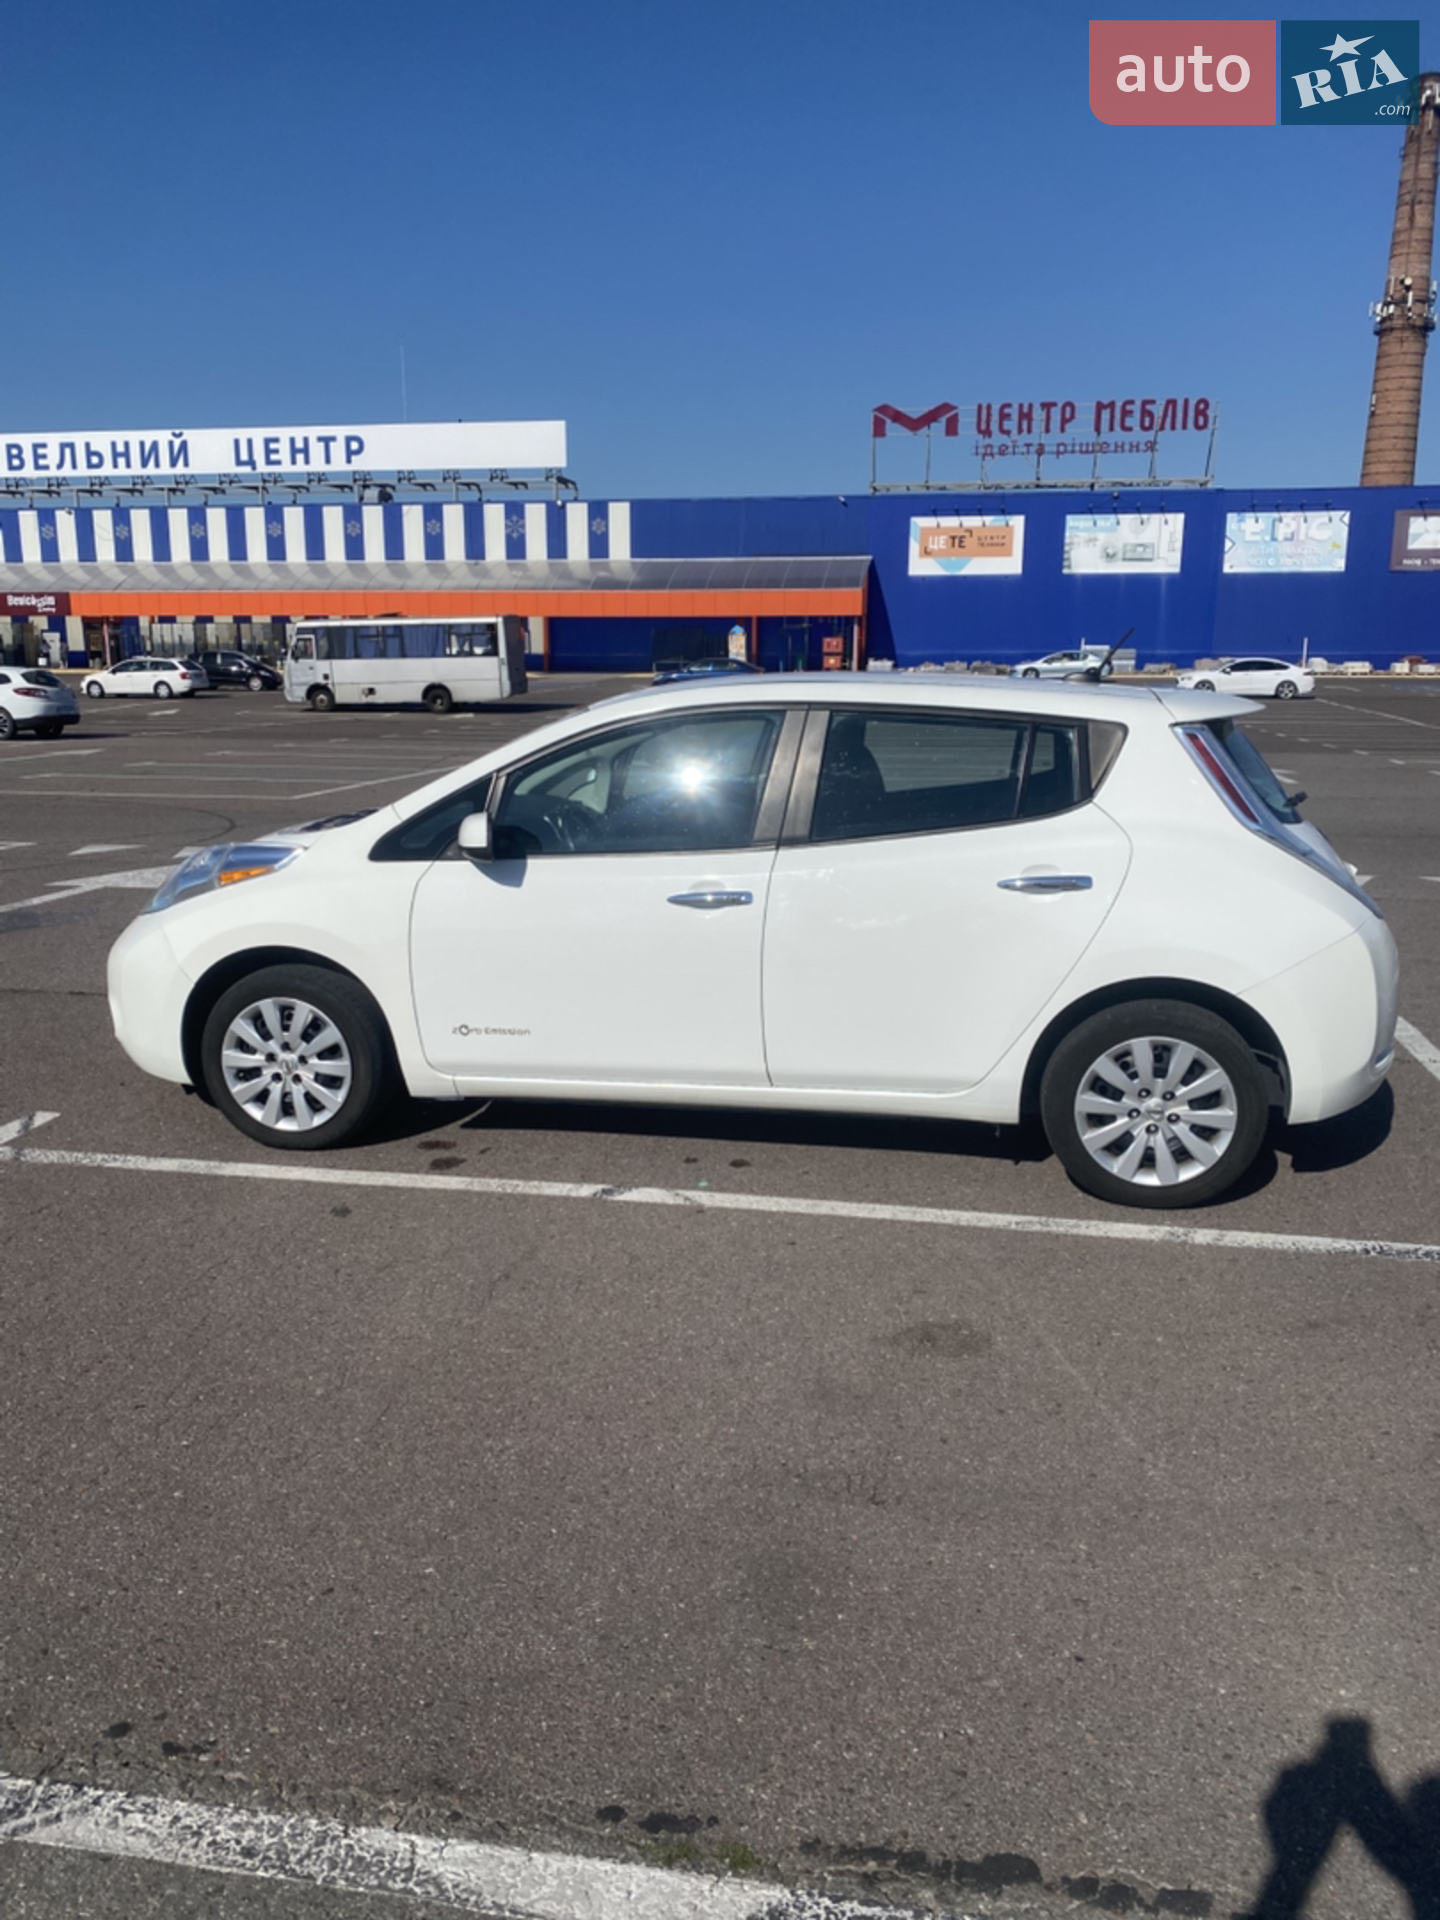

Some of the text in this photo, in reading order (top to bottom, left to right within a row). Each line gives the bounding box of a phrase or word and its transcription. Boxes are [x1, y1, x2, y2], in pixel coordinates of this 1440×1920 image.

[975, 397, 1210, 438] ЦЕНТР МЕБЛІВ
[5, 431, 366, 472] ВЕЛЬНИЙ ЦЕНТР
[1055, 437, 1155, 459] рішення
